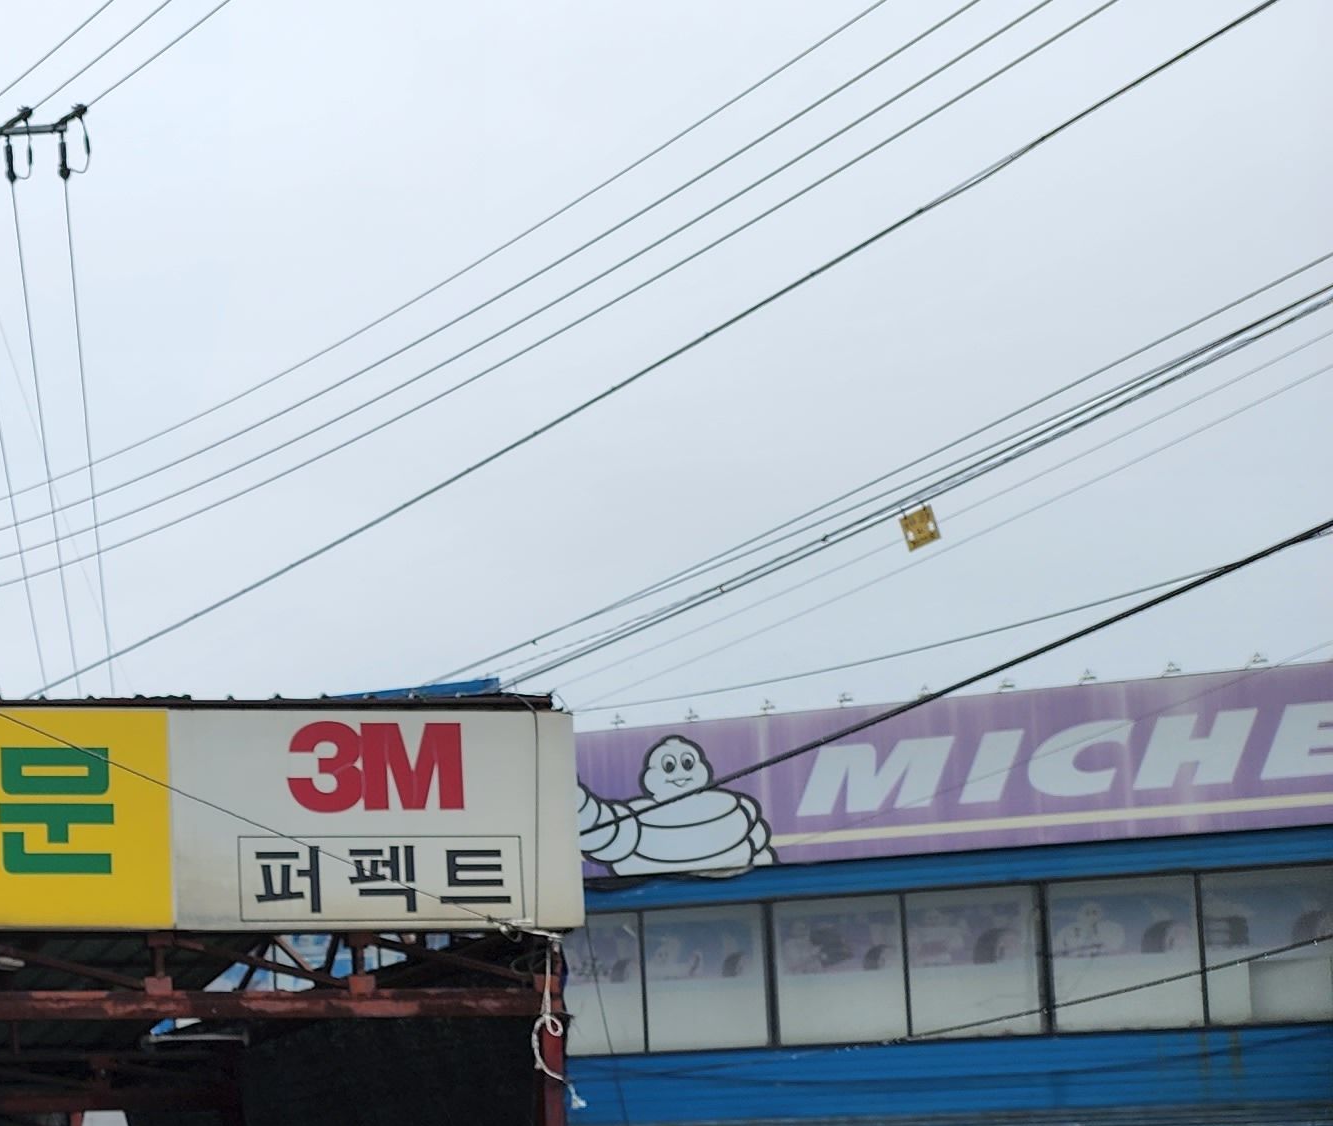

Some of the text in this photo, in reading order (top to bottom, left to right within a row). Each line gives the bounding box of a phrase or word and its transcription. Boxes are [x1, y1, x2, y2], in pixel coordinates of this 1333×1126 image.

[286, 720, 466, 814] 3M
[796, 702, 1333, 818] MICHE
[254, 845, 512, 914] 퍼펙트
